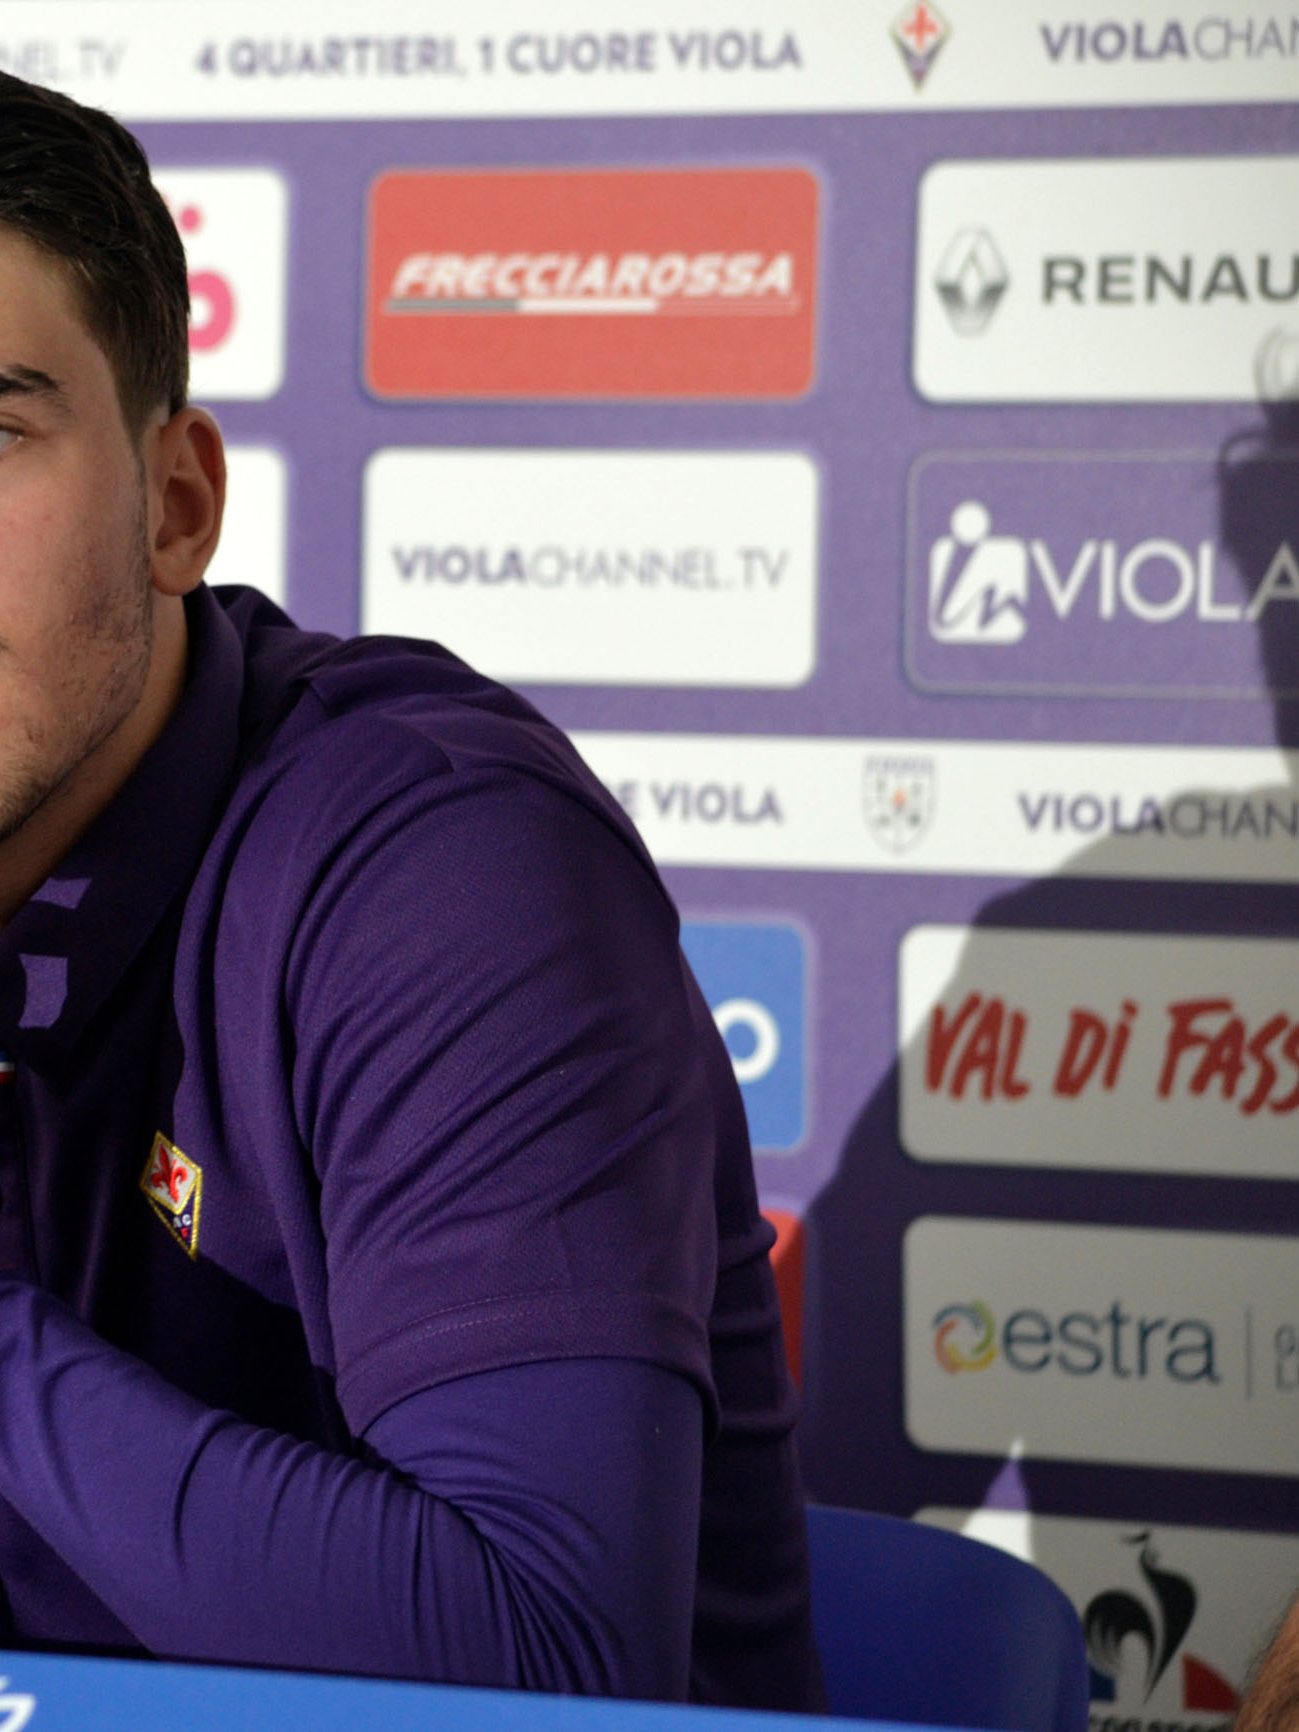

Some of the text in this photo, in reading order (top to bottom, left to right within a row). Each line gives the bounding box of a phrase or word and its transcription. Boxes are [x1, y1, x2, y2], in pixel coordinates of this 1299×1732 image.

[195, 41, 218, 76] 4
[479, 37, 495, 73] 1
[505, 34, 658, 74] CUORE
[667, 30, 803, 73] VIOLA
[1038, 16, 1299, 63] VIOLACHA
[391, 252, 795, 299] FRECCIAROSSA
[1042, 253, 1299, 305] RENAU
[391, 543, 791, 591] VIOLACHANNEL.TV
[650, 782, 785, 826] VIOLA
[926, 991, 1030, 1101] VAL
[1004, 1301, 1222, 1386] estra
